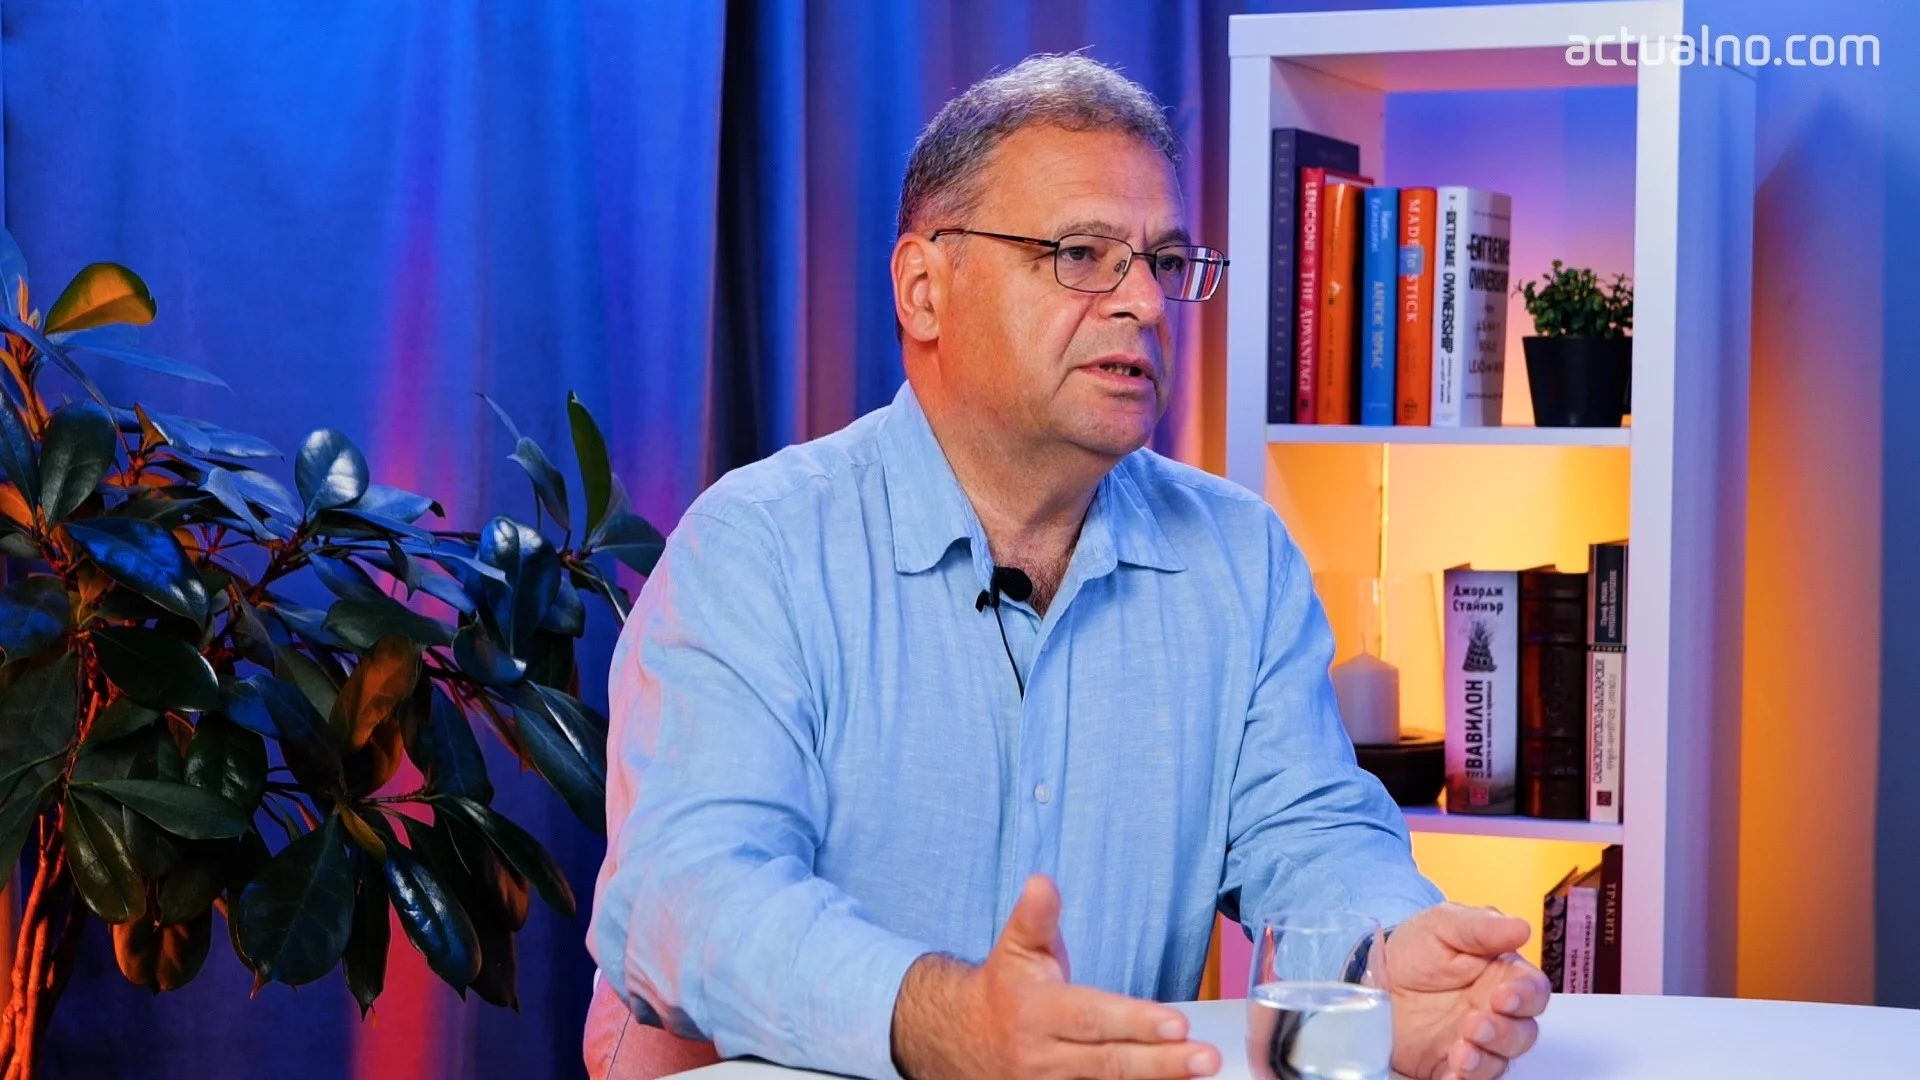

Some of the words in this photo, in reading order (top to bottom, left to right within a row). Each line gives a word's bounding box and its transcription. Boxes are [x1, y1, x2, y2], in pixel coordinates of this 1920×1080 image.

[1303, 181, 1318, 251] LENCIONI
[1407, 199, 1421, 247] MADE
[1444, 211, 1457, 267] EXTREME
[1301, 269, 1315, 304] THE
[1406, 273, 1419, 322] STICK
[1441, 272, 1456, 354] OWNERSHIP
[1299, 306, 1314, 393] ADVANTAGE
[1453, 584, 1504, 600] Джордж
[1453, 599, 1504, 615] Стайнър
[1465, 680, 1483, 769] ВАВИЛОН
[1604, 882, 1617, 945] ТРАКИТЕ
